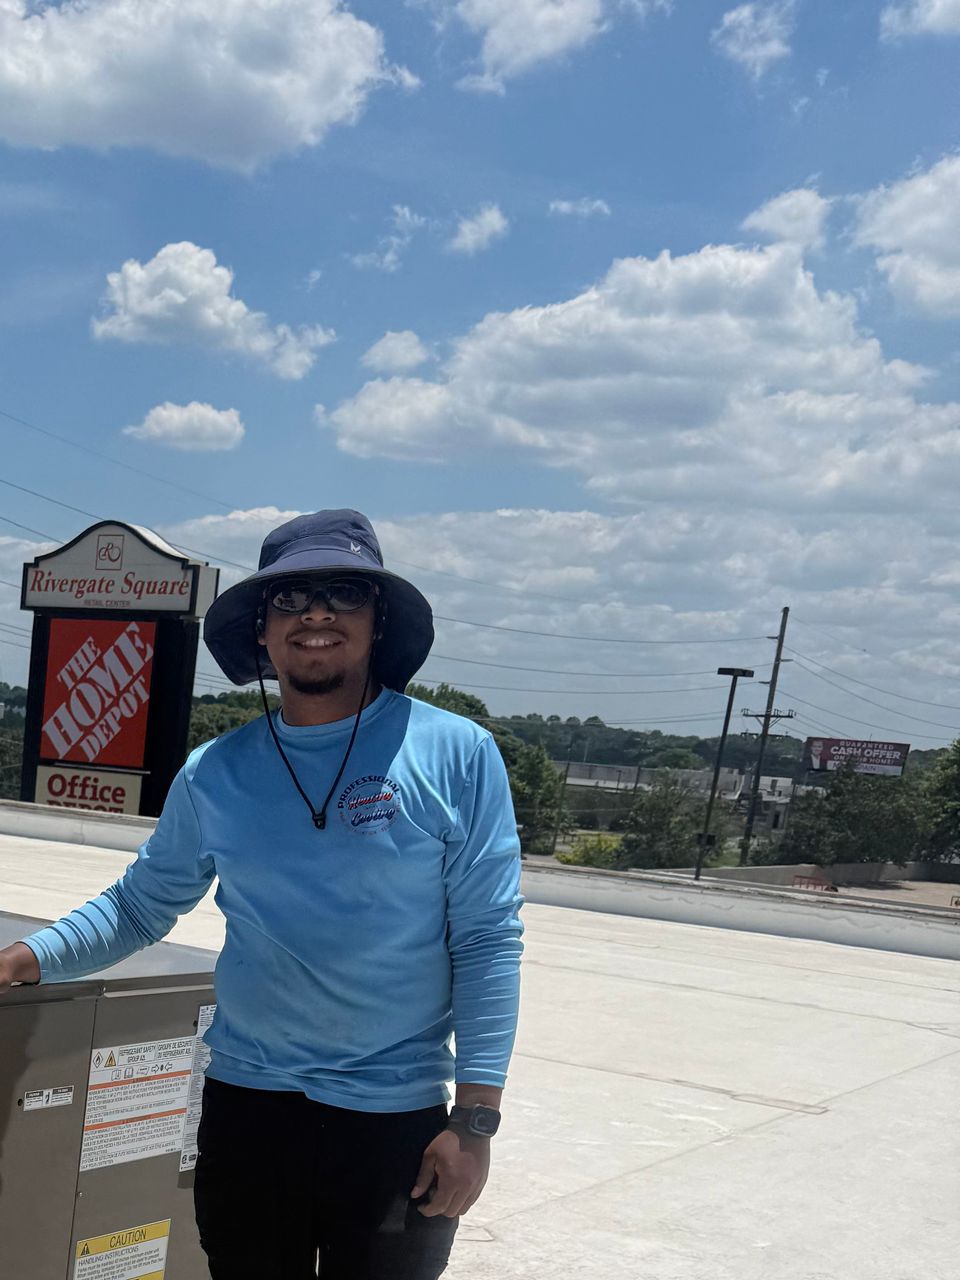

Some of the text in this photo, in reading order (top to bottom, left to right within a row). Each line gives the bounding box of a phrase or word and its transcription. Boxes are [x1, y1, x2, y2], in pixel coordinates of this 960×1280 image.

[30, 570, 189, 600] Rivergate Square
[57, 636, 102, 691] THE
[42, 621, 154, 760] HOME
[79, 675, 150, 762] DEPOT
[830, 746, 901, 760] CASH OFFER
[840, 740, 895, 750] GUARANTEED
[47, 773, 126, 804] Office
[337, 775, 400, 809] PROFESSIONAL
[109, 1228, 147, 1248] CAUTION
